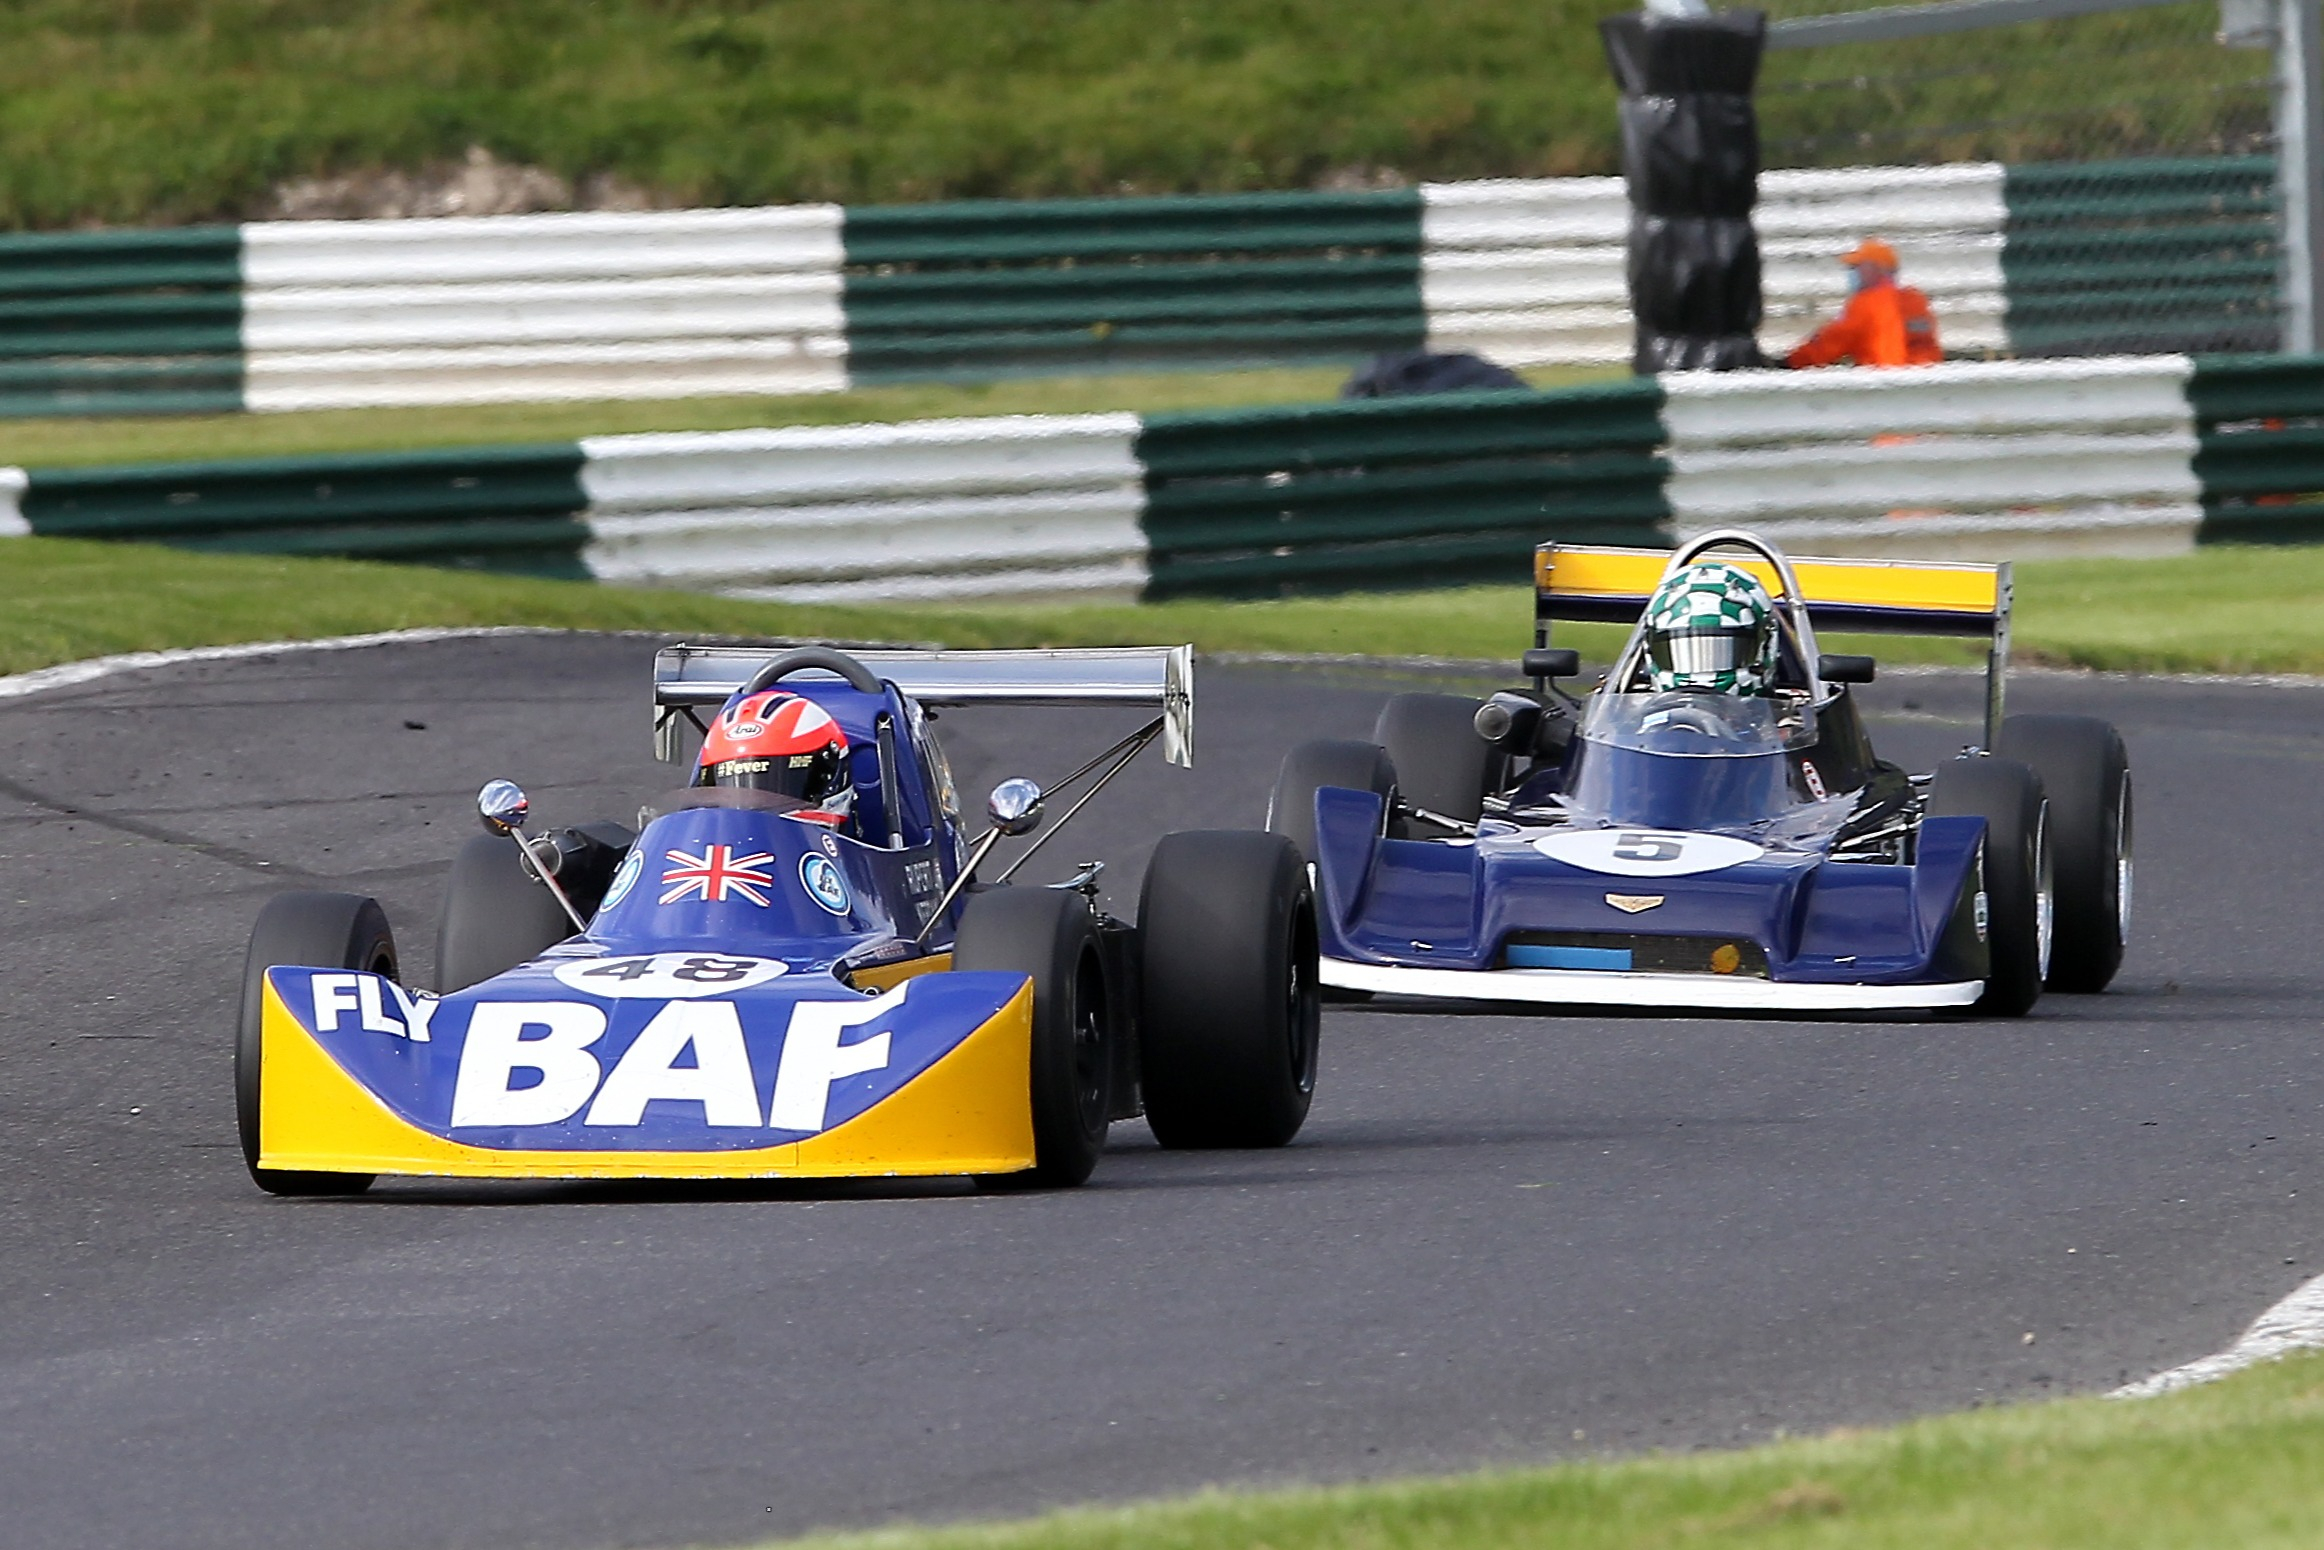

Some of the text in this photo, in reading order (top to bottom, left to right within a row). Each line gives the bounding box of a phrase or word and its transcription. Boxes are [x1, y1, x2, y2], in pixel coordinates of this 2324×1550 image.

[718, 760, 770, 777] #Fever
[1613, 834, 1686, 861] 5
[582, 958, 759, 982] 48
[311, 974, 440, 1042] FLY
[451, 979, 910, 1131] BAF
